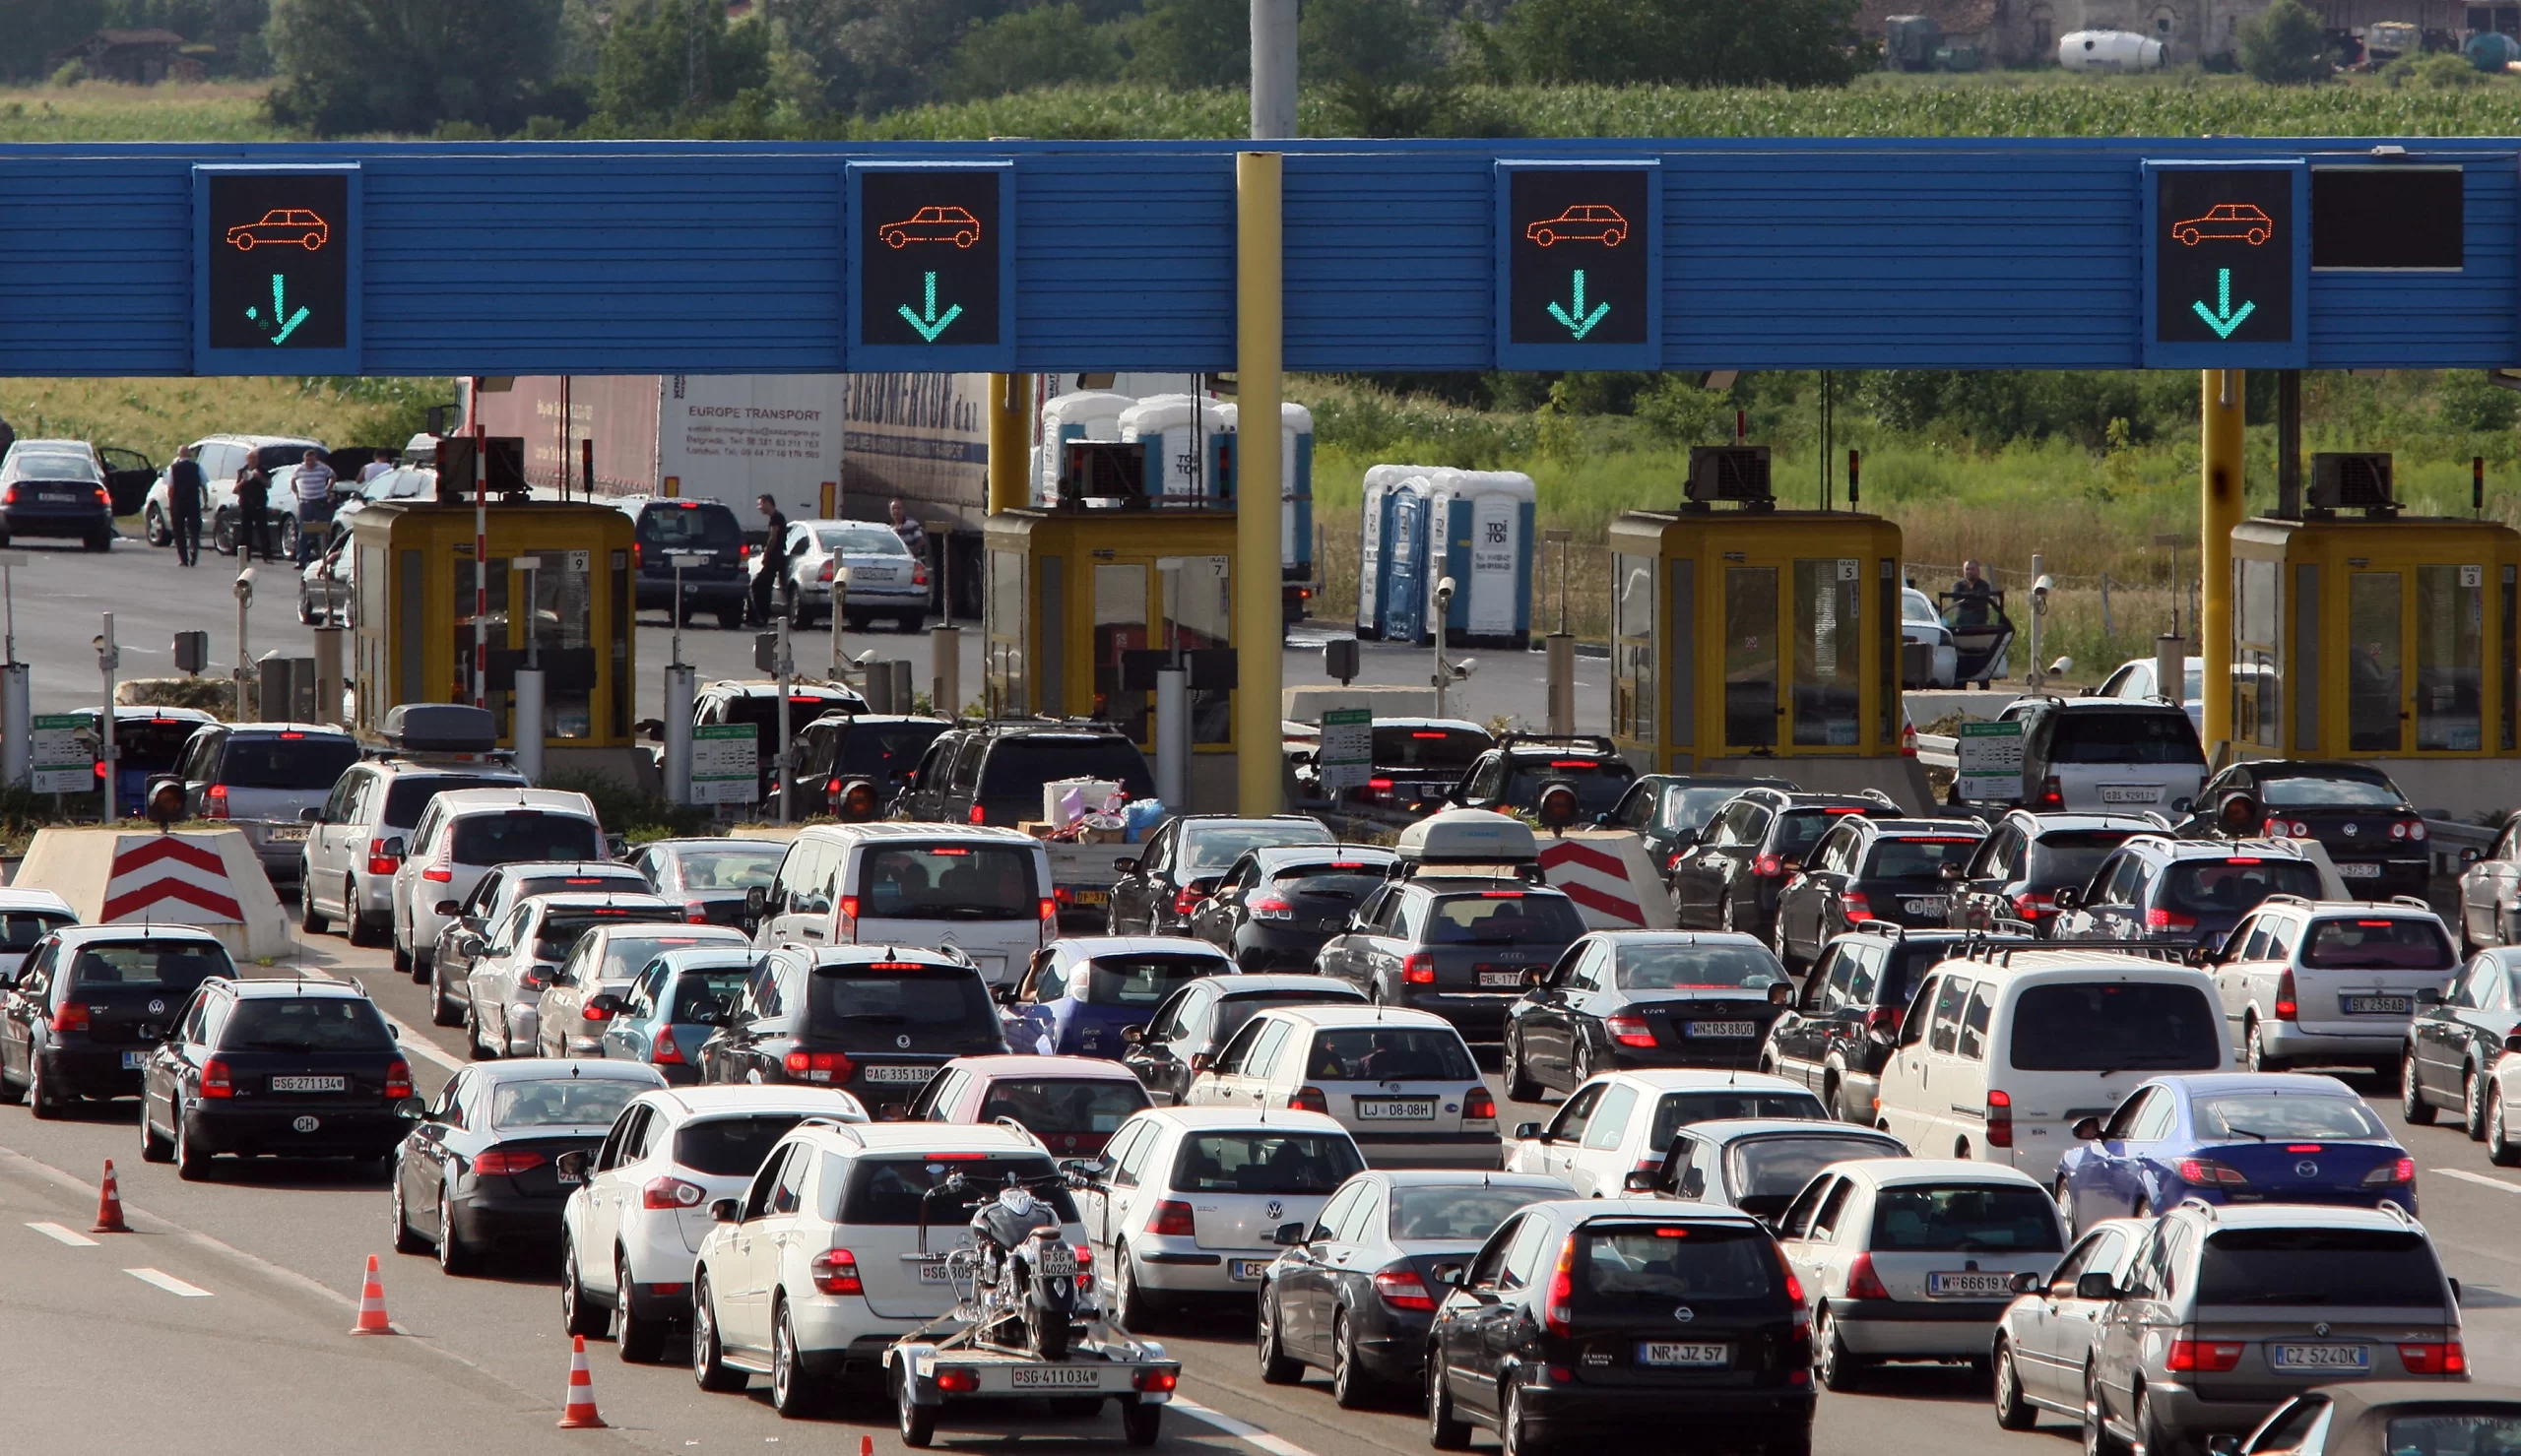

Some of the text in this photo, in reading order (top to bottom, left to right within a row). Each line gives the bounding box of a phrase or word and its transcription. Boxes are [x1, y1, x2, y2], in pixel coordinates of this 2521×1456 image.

[689, 406, 821, 421] EUROPE TRANSPORT
[575, 558, 583, 570] 9
[1214, 564, 1222, 576] 7
[1844, 567, 1852, 578] 5
[2468, 573, 2475, 585] 3
[1908, 901, 1921, 912] CH
[743, 918, 757, 928] FL
[2353, 998, 2368, 1011] BK
[1363, 1104, 1428, 1116] LJ D8-08H
[297, 1117, 314, 1130] CH
[1052, 1250, 1066, 1262] SG
[1045, 1263, 1073, 1275] 40226
[1245, 1263, 1261, 1277] CE
[1941, 1277, 1949, 1290] W
[1960, 1277, 1999, 1290] 66619
[1651, 1345, 1722, 1361] NR JZ 57
[2286, 1348, 2303, 1363] CZ
